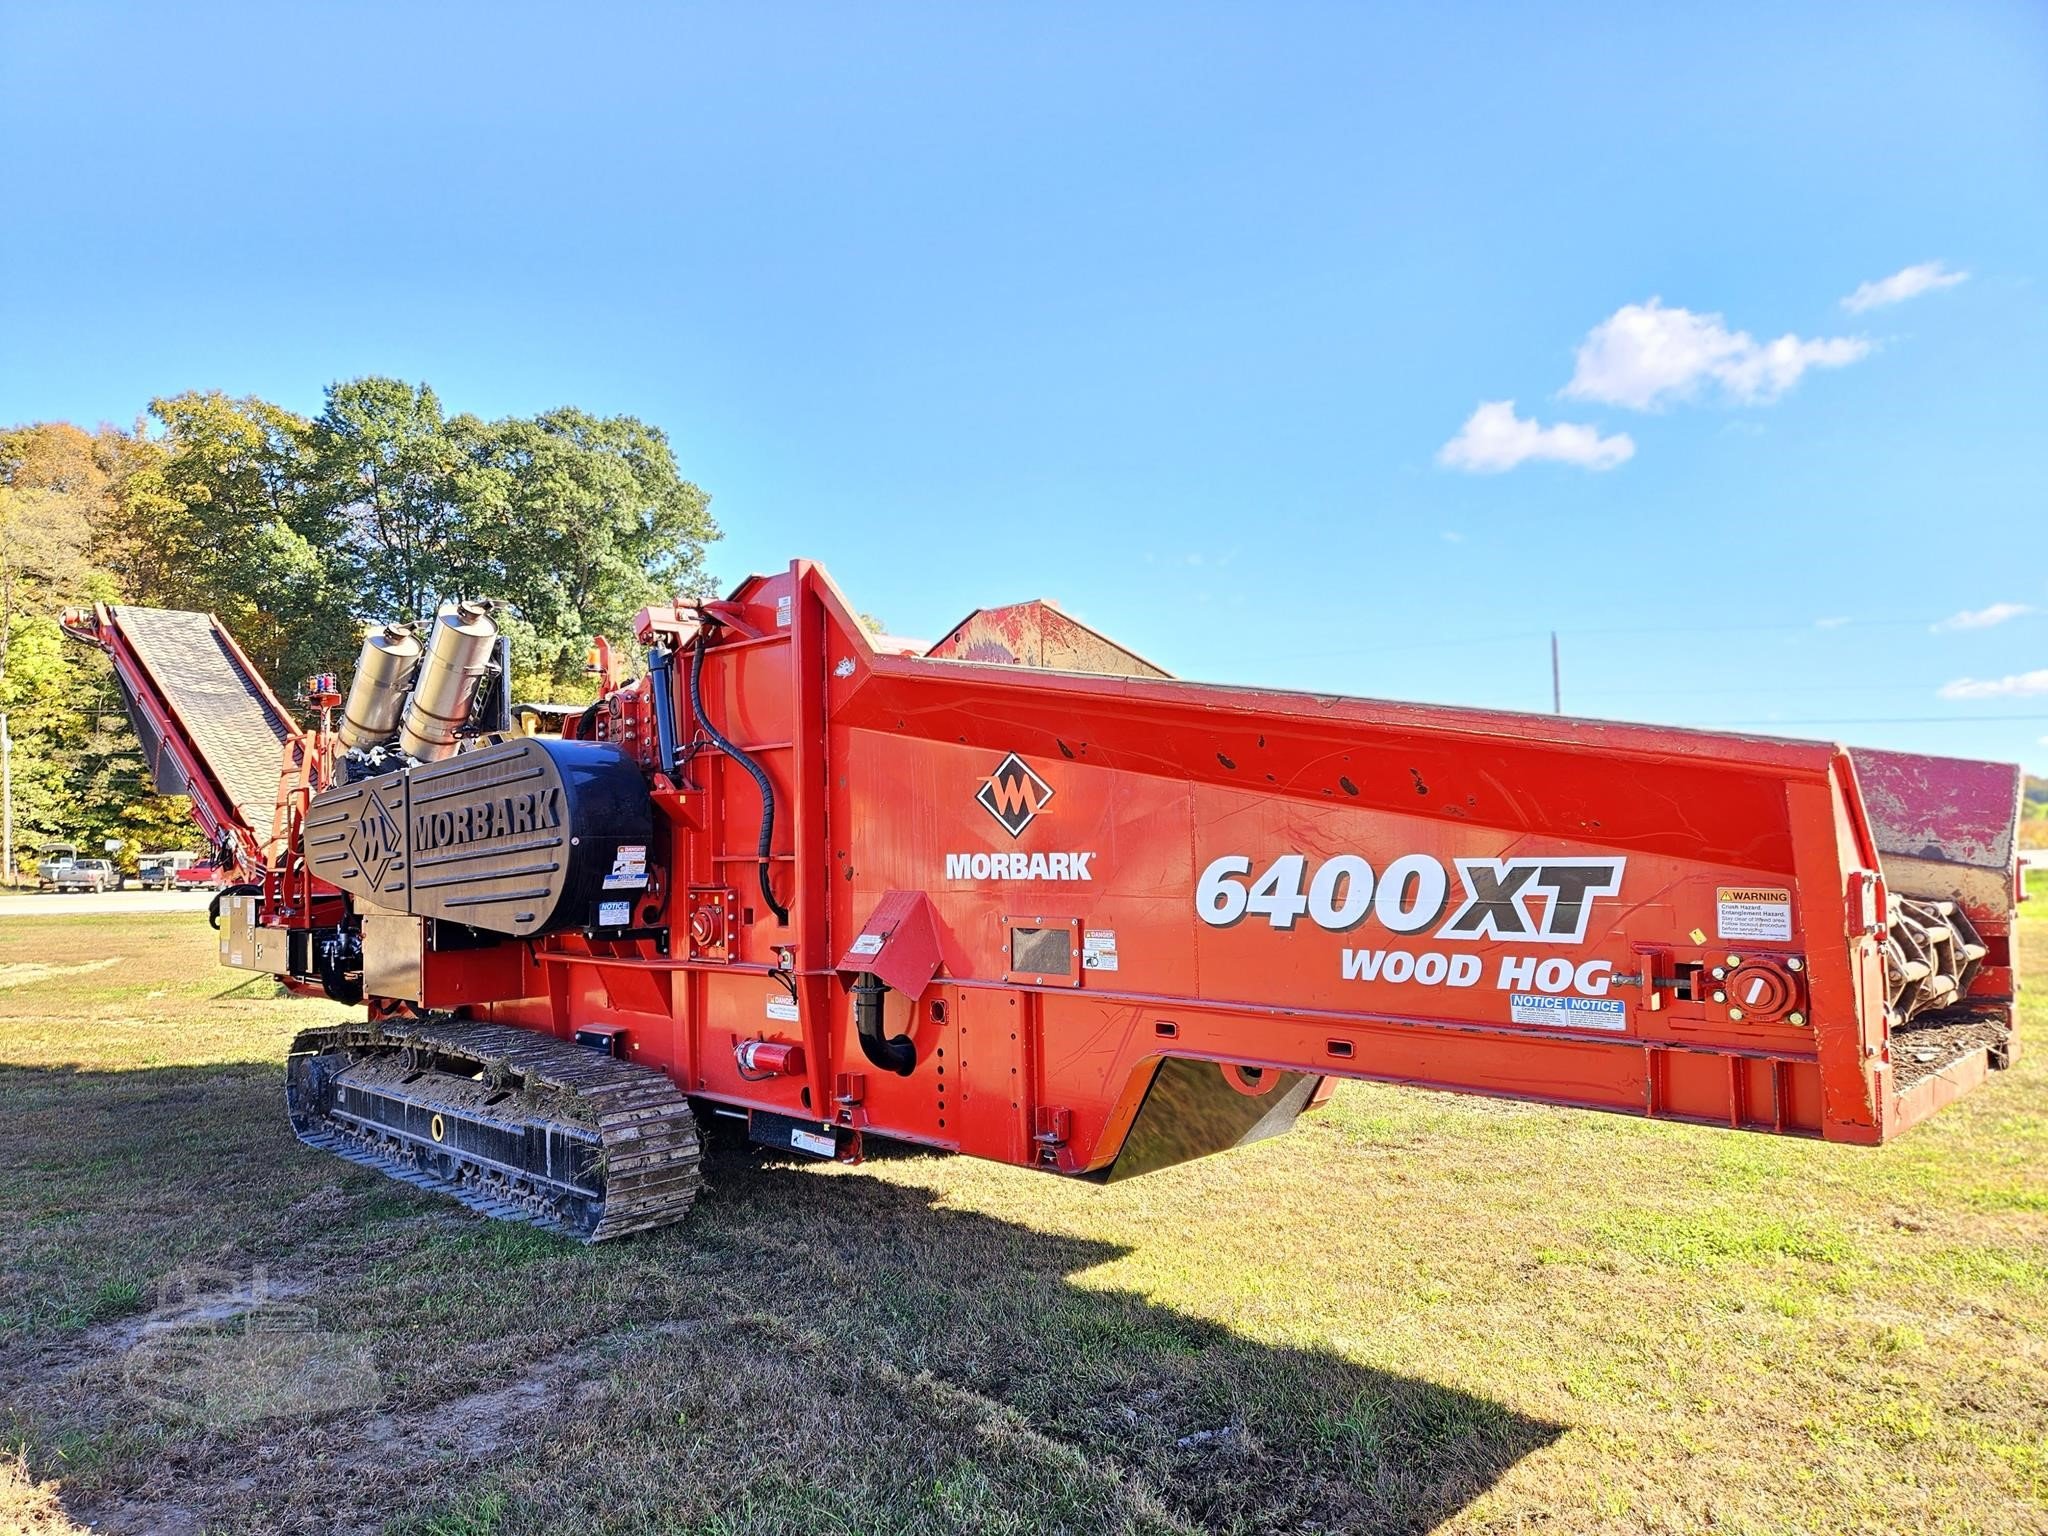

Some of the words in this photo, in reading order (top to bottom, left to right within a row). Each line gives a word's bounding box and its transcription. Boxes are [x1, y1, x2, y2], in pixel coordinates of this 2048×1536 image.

[414, 788, 560, 851] MORBARK
[945, 852, 1093, 881] MORBARK
[1732, 892, 1787, 902] WARNING
[601, 902, 628, 910] NOTICE
[1341, 948, 1482, 987] WOOD
[1496, 955, 1612, 996] HOG
[1513, 995, 1563, 1008] NOTICE
[1571, 999, 1620, 1011] NOTICE
